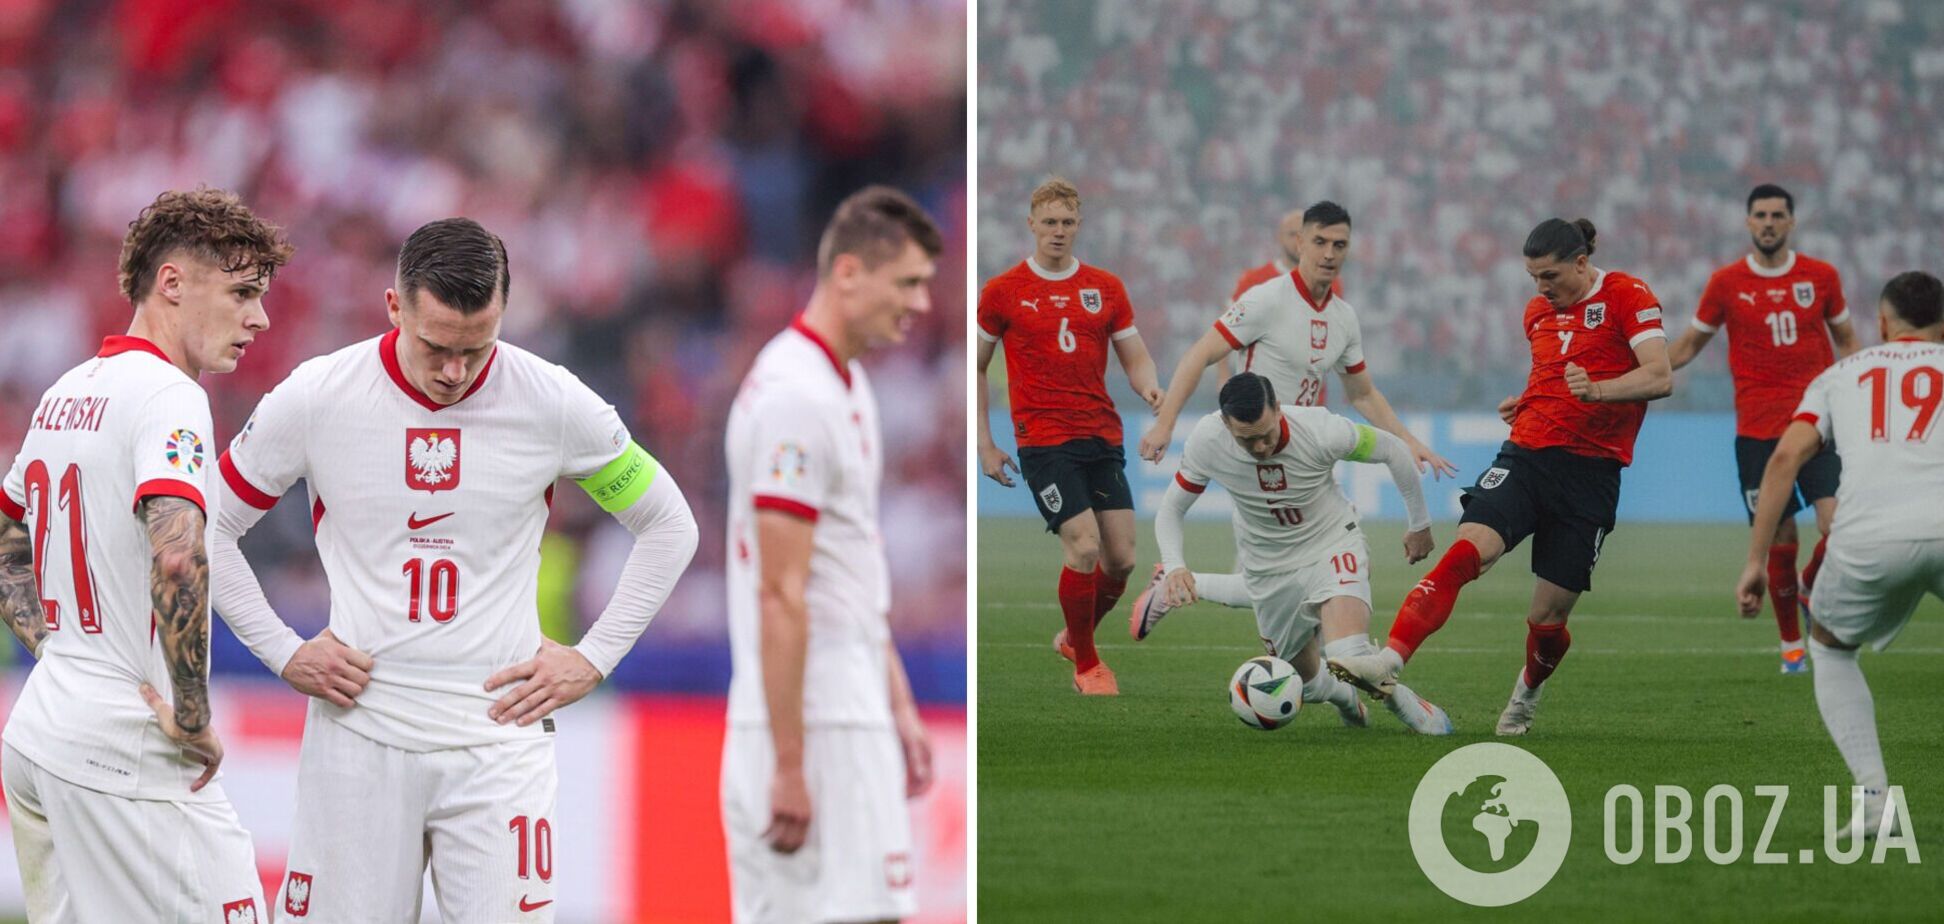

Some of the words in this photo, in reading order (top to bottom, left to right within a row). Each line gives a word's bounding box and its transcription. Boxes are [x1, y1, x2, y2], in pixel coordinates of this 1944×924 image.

[1058, 317, 1076, 353] 6
[1764, 310, 1798, 347] 10
[30, 396, 110, 432] ALEWSKI
[1858, 366, 1944, 443] 19
[609, 453, 642, 494] RESPECT
[1270, 507, 1304, 527] 10
[23, 459, 102, 634] 21
[1330, 552, 1357, 574] 10
[402, 557, 460, 625] 10
[509, 815, 552, 884] 10
